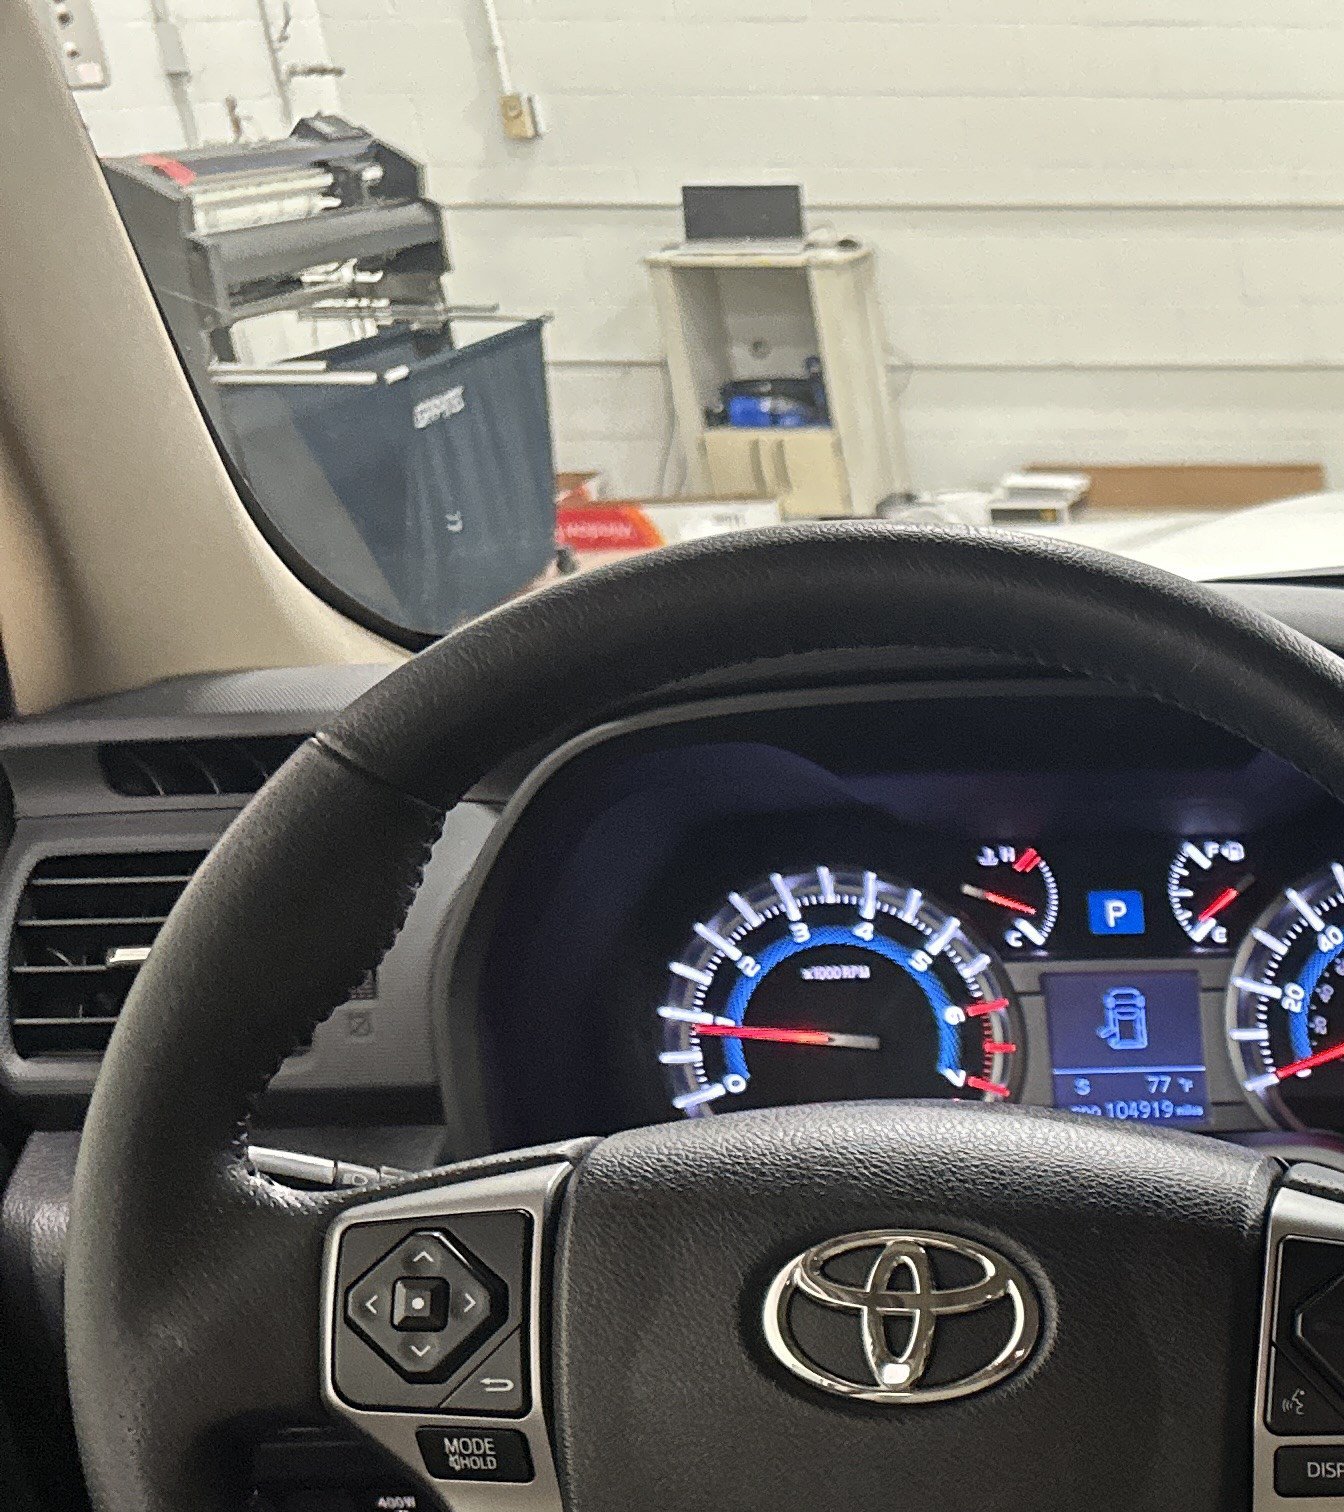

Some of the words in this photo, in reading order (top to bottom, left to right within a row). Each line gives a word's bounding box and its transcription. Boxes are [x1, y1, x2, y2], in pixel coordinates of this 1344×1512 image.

[998, 845, 1016, 863] H
[1203, 841, 1220, 858] F
[1104, 900, 1127, 928] P
[791, 922, 811, 943] 3
[852, 922, 875, 941] 4
[1317, 926, 1344, 952] 40
[736, 955, 761, 977] 2
[908, 949, 933, 972] 5
[1281, 982, 1305, 1013] 20
[945, 1005, 966, 1025] 6
[722, 1074, 746, 1094] 0
[1074, 1077, 1091, 1096] S
[1145, 1075, 1172, 1094] 77
[1105, 1100, 1174, 1119] 104919
[444, 1437, 497, 1455] MODE
[461, 1456, 497, 1470] HOLD
